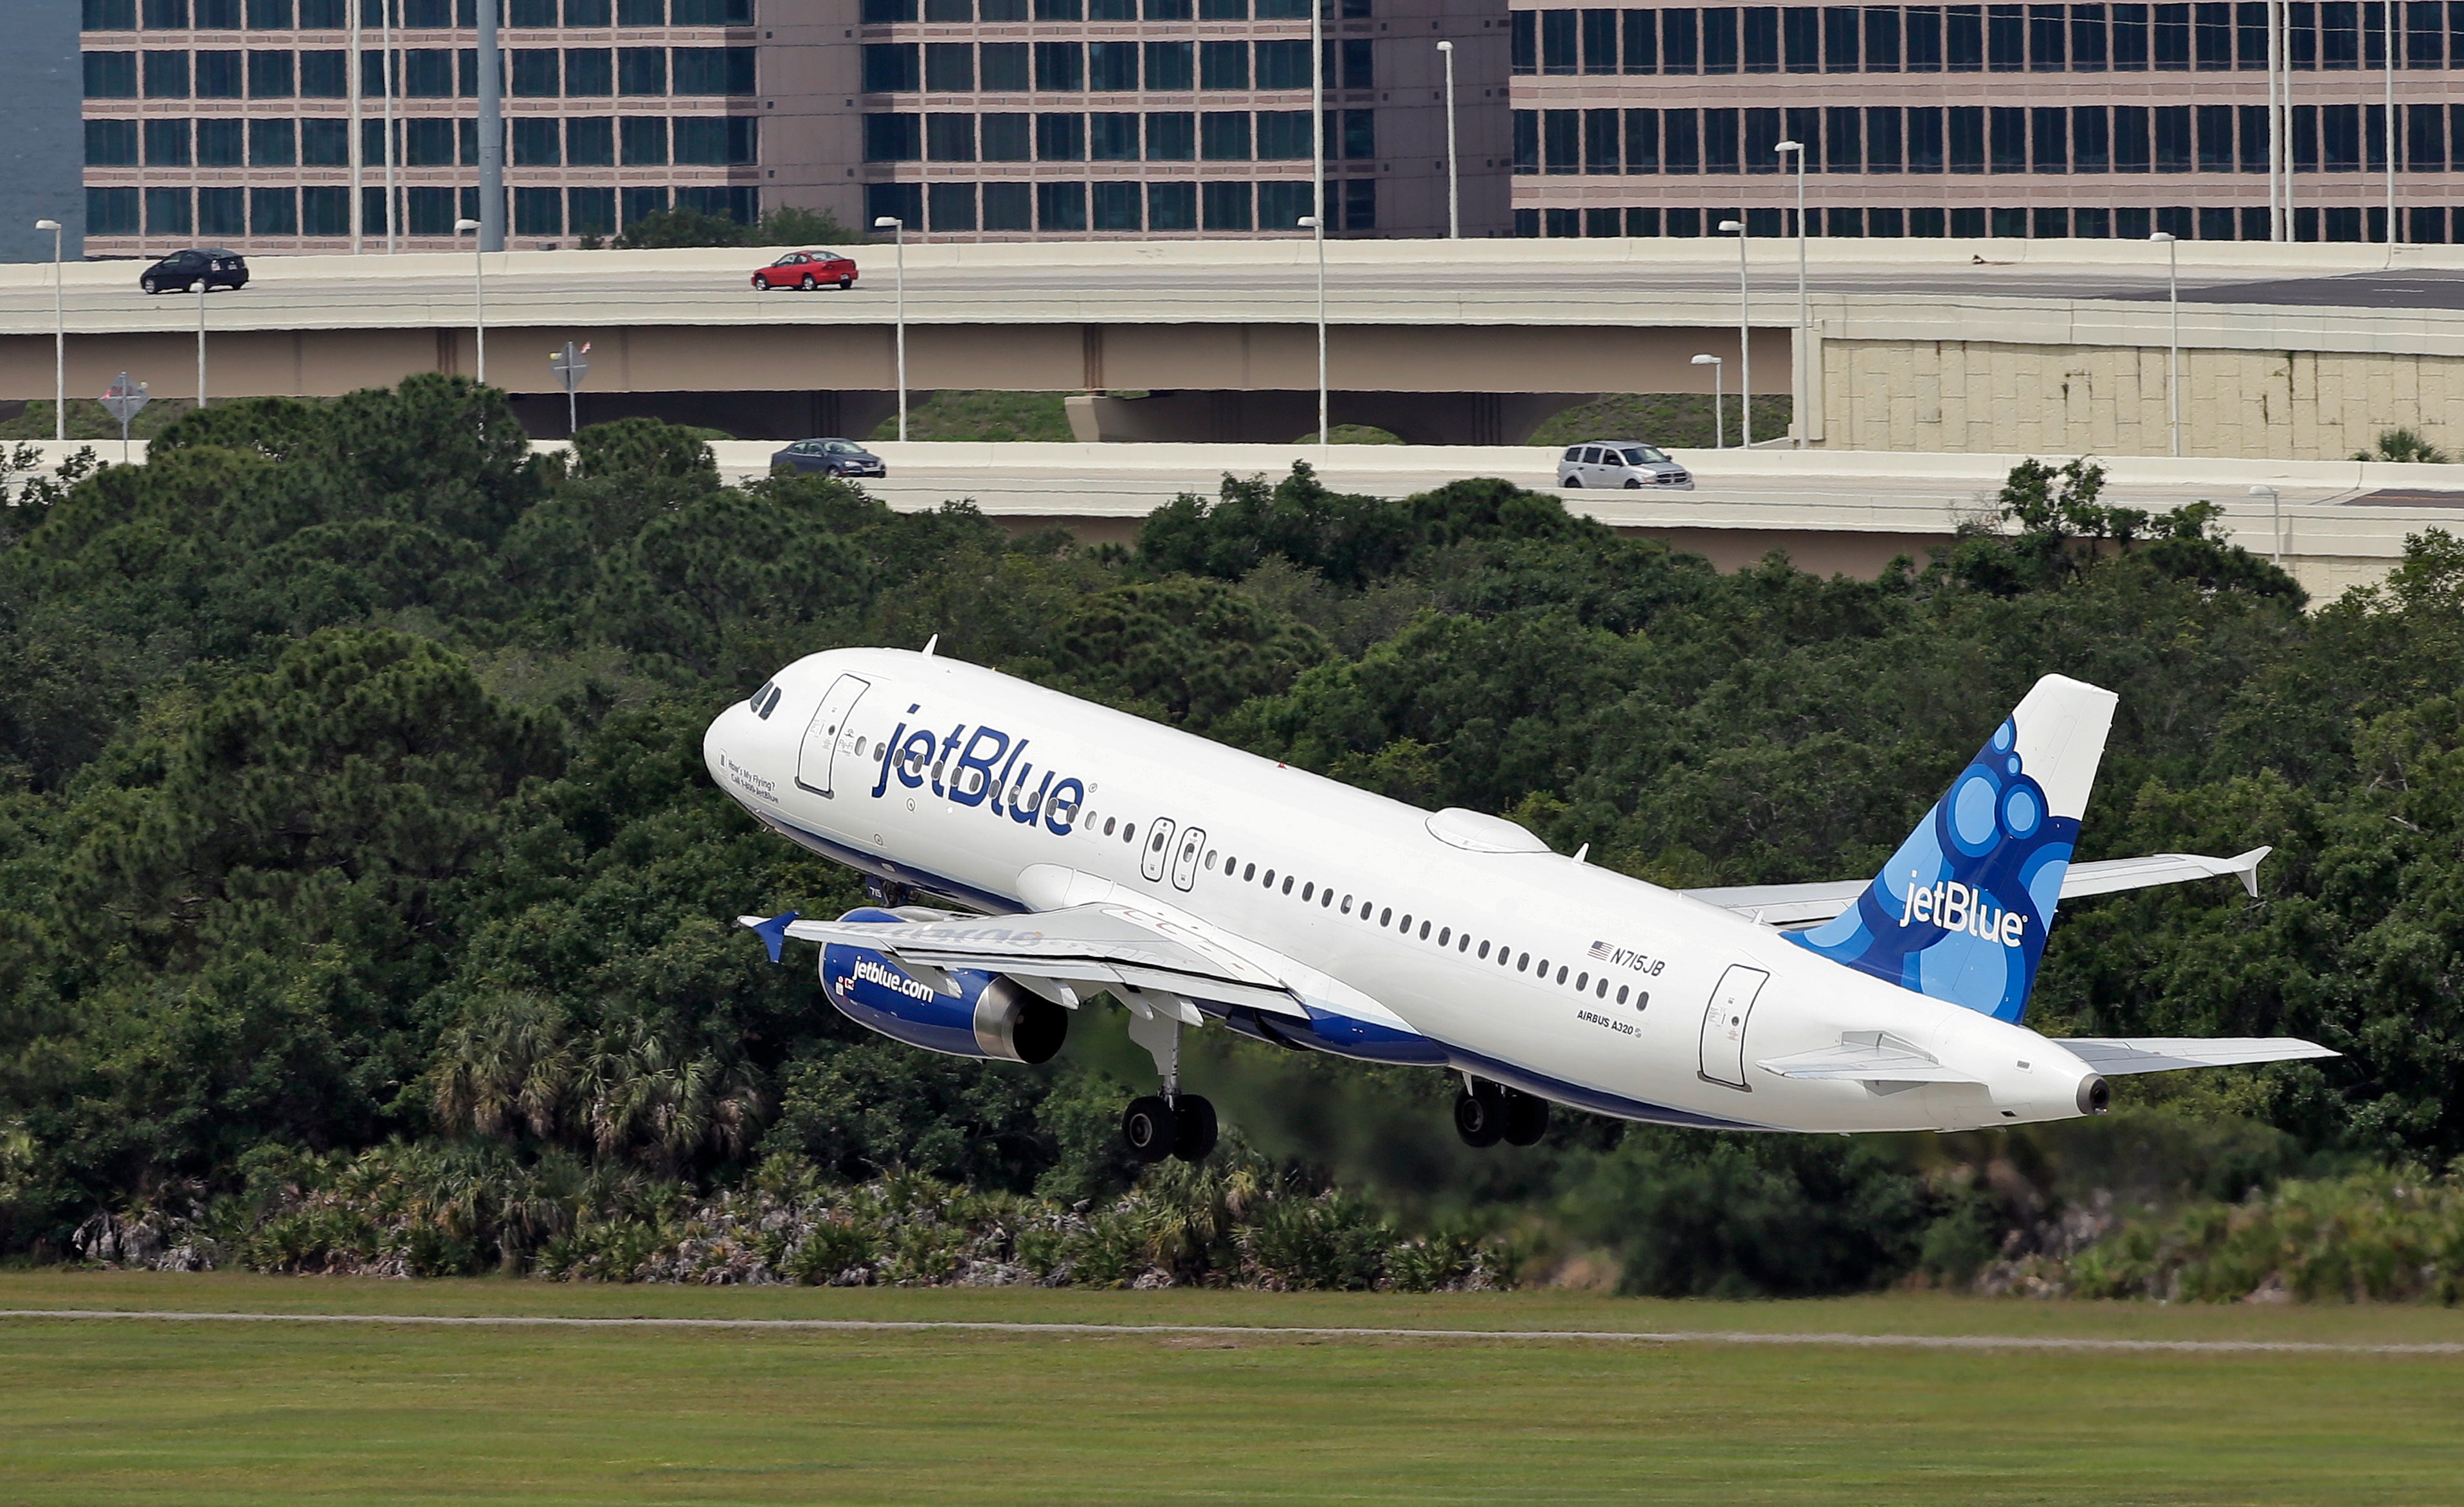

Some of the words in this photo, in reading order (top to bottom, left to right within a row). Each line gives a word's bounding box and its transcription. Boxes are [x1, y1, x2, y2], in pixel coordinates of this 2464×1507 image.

[731, 773, 740, 785] Call
[743, 769, 752, 782] My
[753, 774, 775, 791] Flying?
[869, 886, 882, 898] 715
[1609, 947, 1665, 977] N715JB
[852, 956, 934, 1003] jetblue.com
[1577, 1010, 1610, 1028] AIRBUS
[1611, 1021, 1634, 1036] A320
